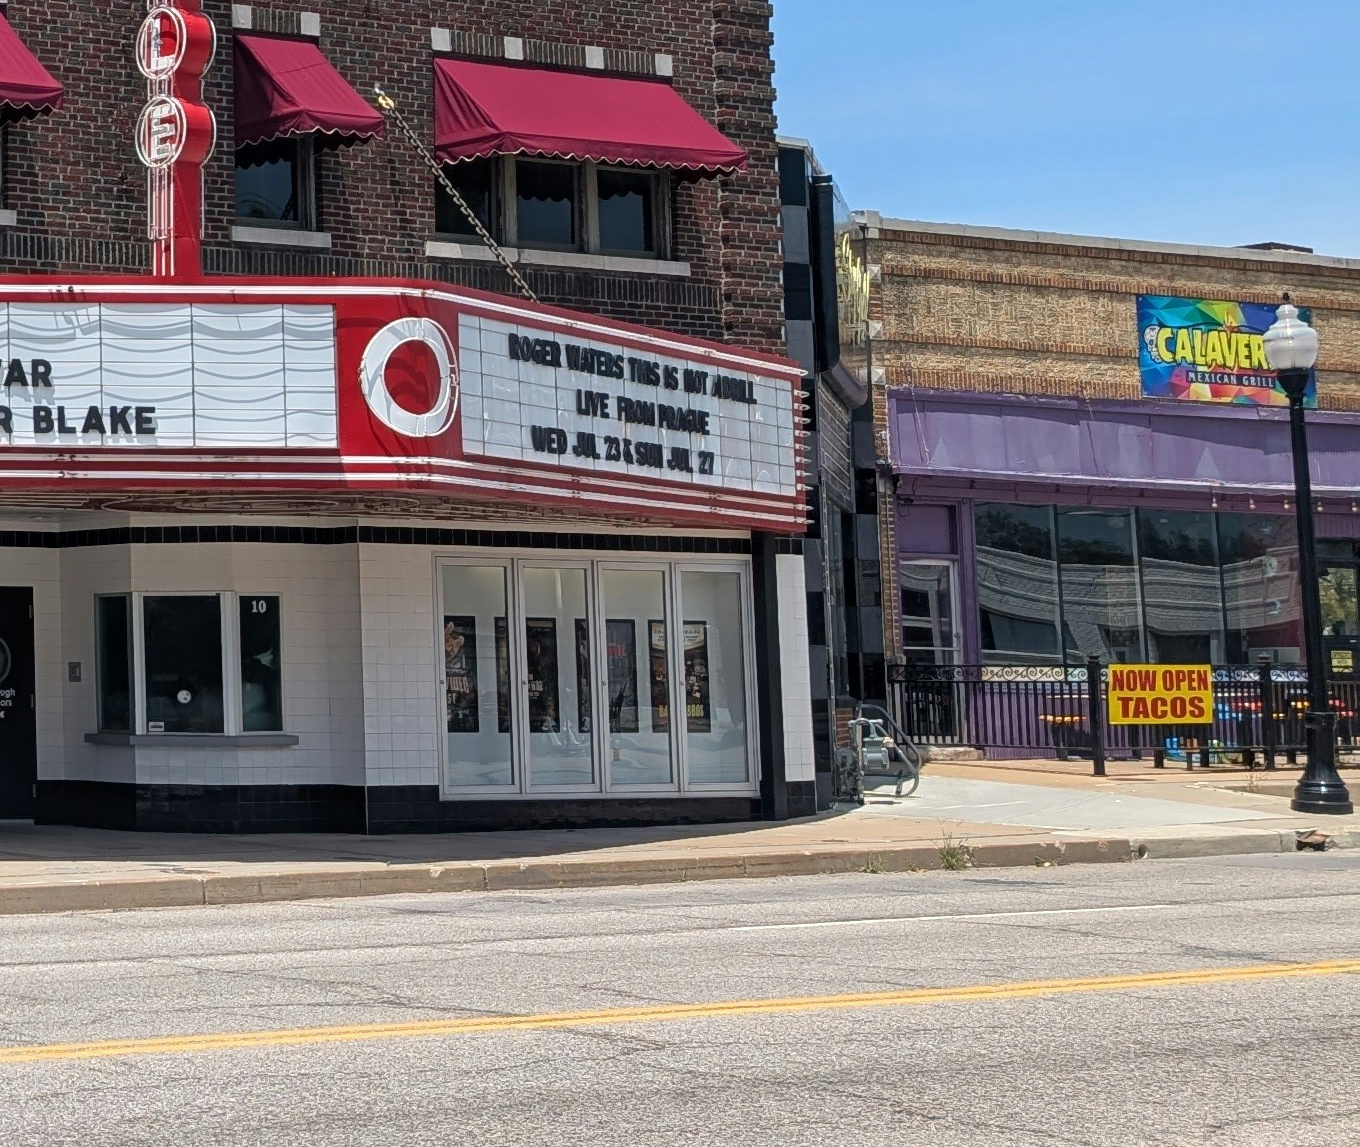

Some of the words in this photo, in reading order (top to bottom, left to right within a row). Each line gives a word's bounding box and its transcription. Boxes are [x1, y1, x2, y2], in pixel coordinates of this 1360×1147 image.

[508, 332, 562, 368] ROGER
[565, 343, 624, 380] WATERS
[627, 357, 661, 386] THIS
[663, 364, 678, 390] IS
[683, 368, 709, 395] NOT
[1157, 326, 1274, 371] CALAVER
[1188, 371, 1238, 385] MEXICAN
[1242, 375, 1275, 388] GRILL
[32, 405, 157, 435] BLAKE
[576, 388, 610, 419] LIVE
[616, 395, 656, 427] FROM
[658, 403, 710, 435] PRAGUE
[531, 424, 568, 454] WED
[572, 431, 601, 460] JUL
[604, 435, 622, 462] 23
[634, 441, 663, 468] SUN
[667, 447, 694, 474] JUL
[698, 451, 715, 475] 27
[251, 600, 267, 613] 10
[1112, 670, 1157, 692] NOW
[1161, 670, 1209, 692] OPEN
[1117, 696, 1205, 720] TACOS
